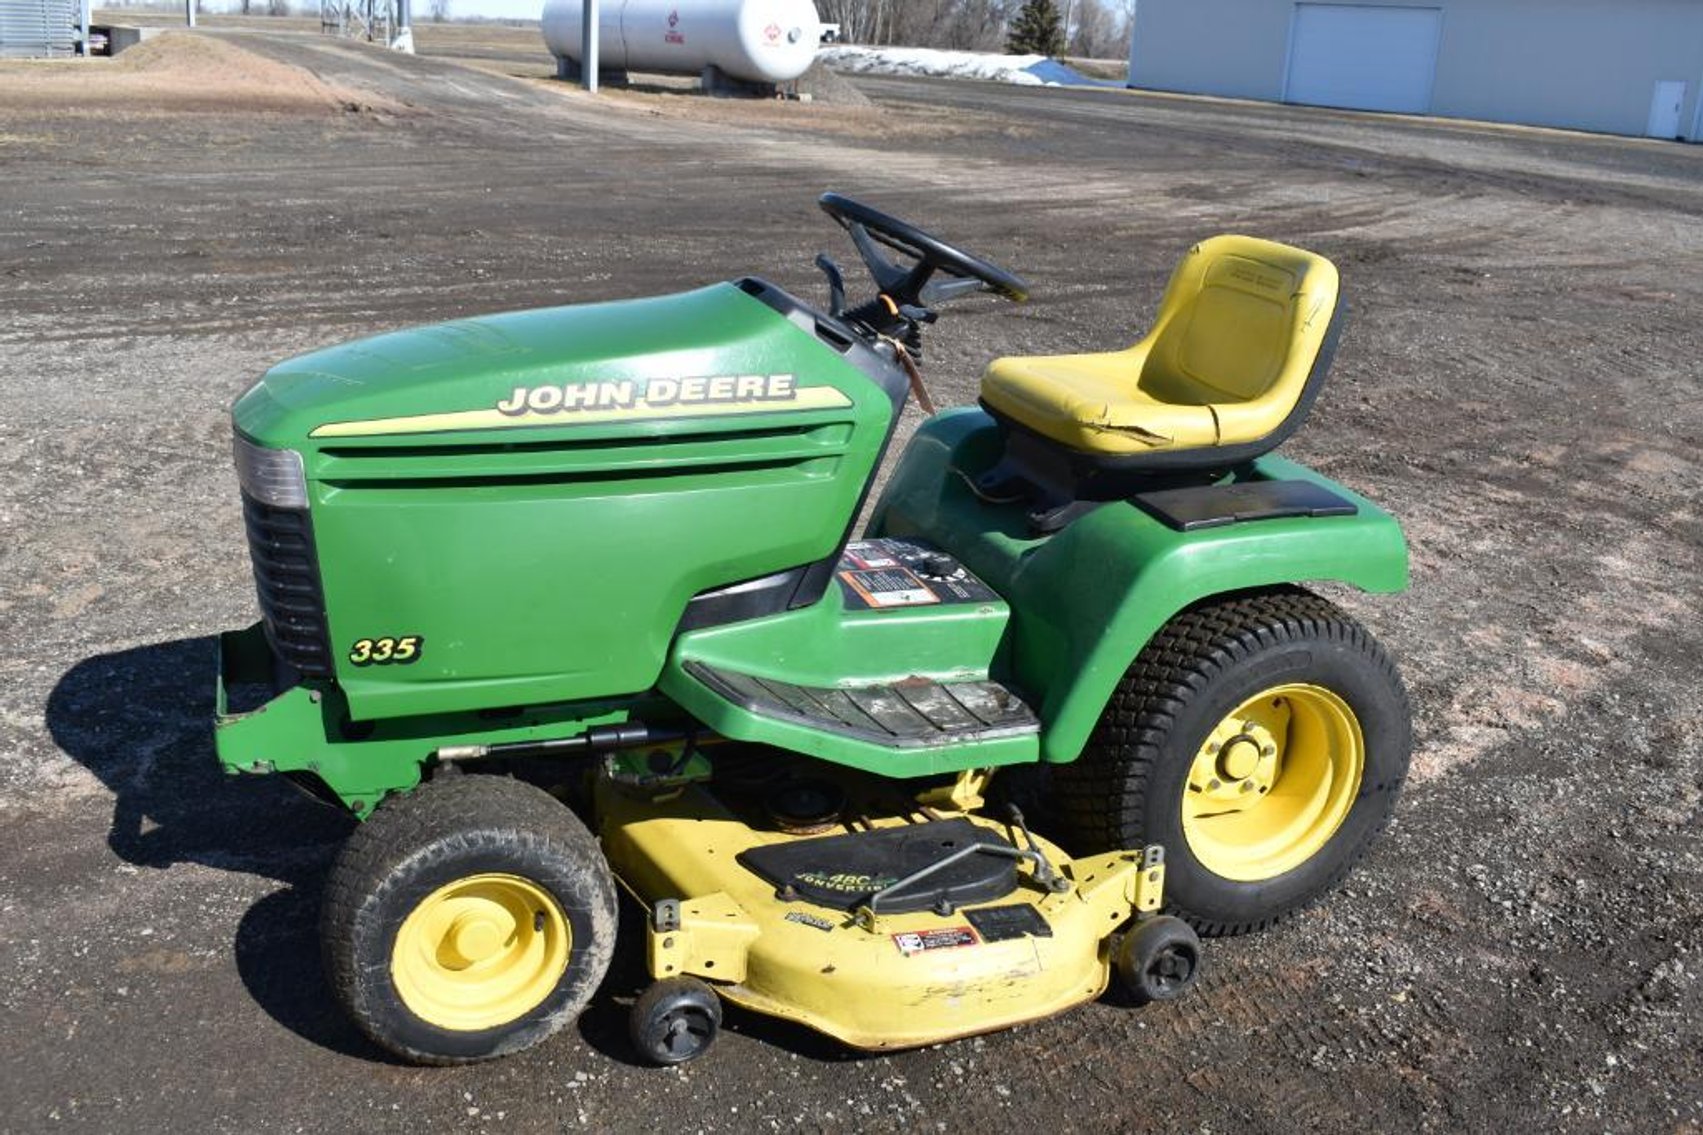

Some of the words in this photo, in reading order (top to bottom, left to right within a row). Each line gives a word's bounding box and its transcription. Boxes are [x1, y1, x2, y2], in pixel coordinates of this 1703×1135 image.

[498, 382, 634, 414] JOHN
[647, 374, 794, 405] DEERE
[350, 637, 419, 664] 335
